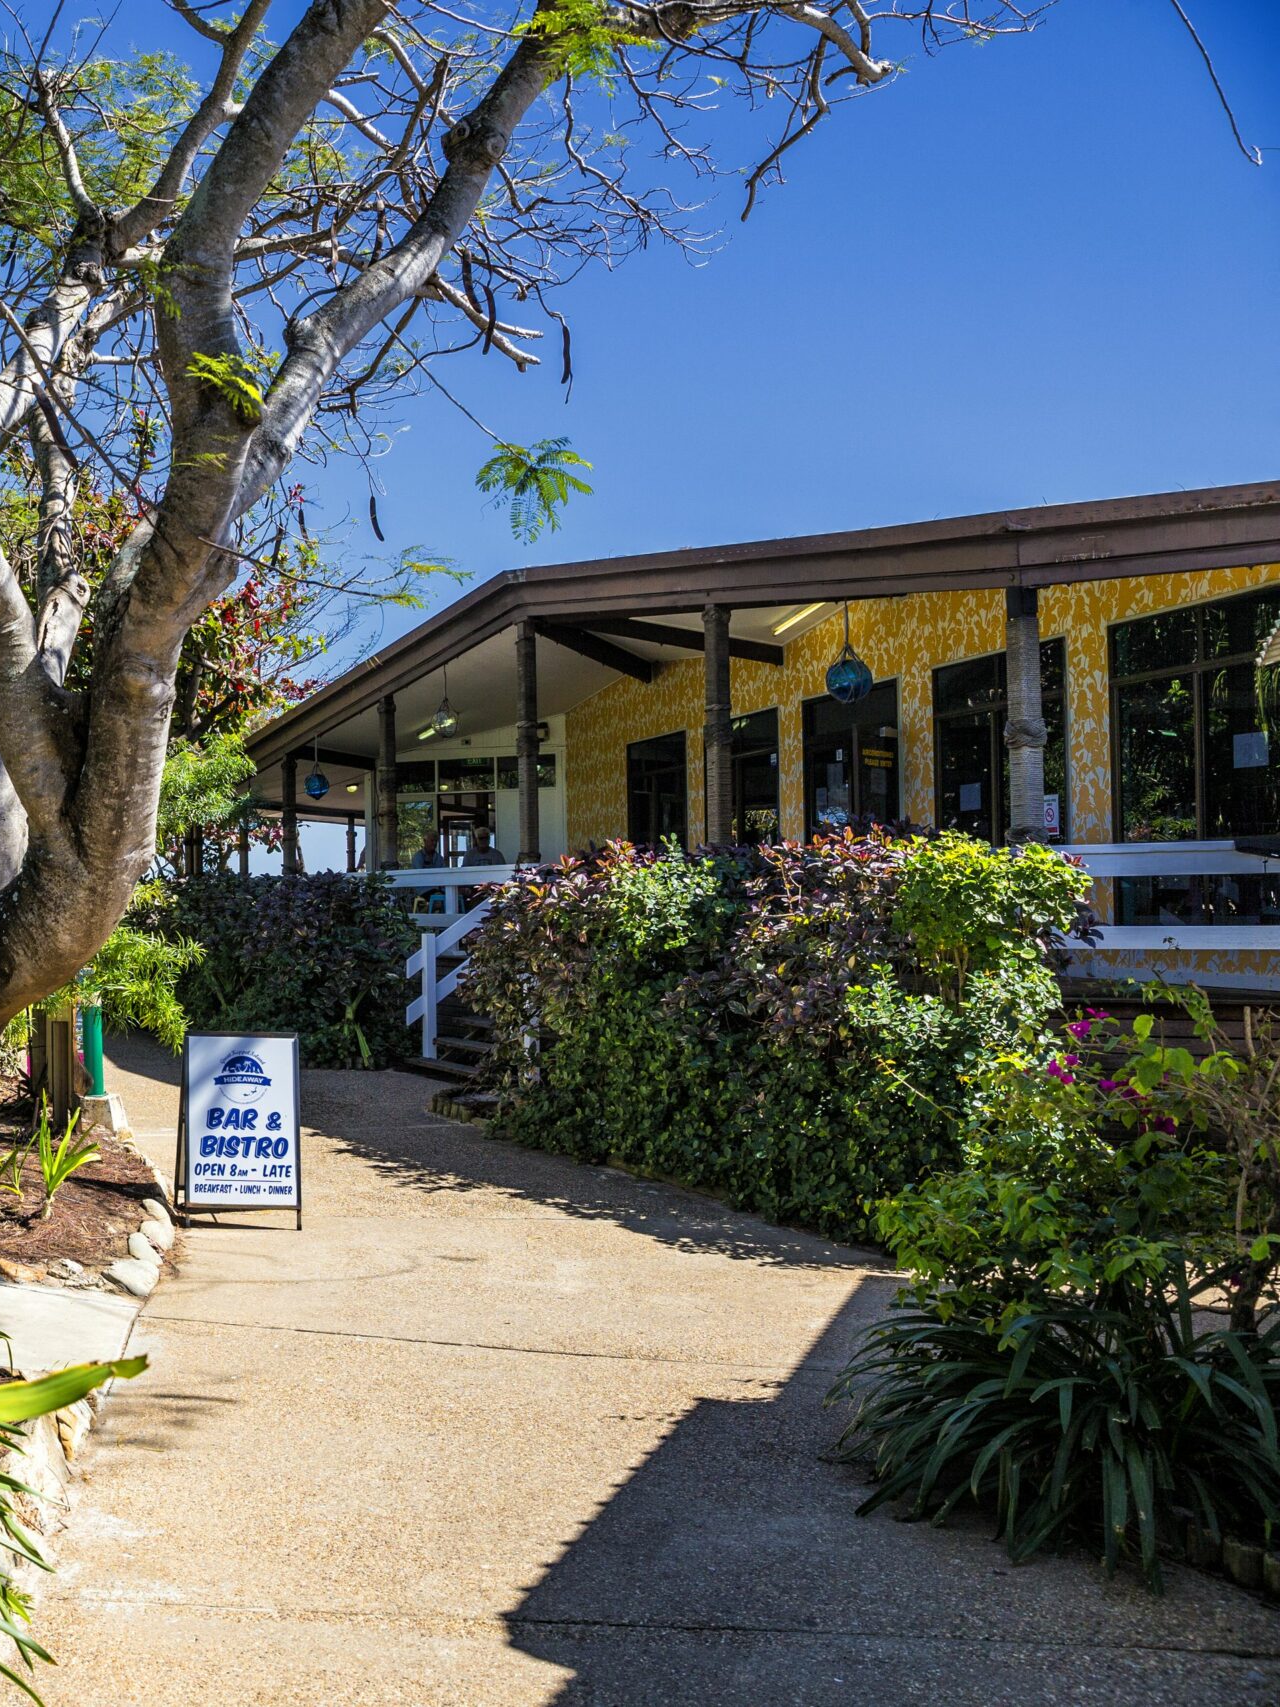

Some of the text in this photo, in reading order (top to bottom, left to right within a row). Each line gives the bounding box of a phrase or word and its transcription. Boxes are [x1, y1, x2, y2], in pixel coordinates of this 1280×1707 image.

[223, 1076, 264, 1084] HIDEAWAY
[206, 1107, 282, 1131] BAR &
[199, 1135, 289, 1159] BISTRO
[194, 1163, 226, 1176] OPEN
[262, 1164, 292, 1178] LATE
[194, 1183, 293, 1195] BREAKFAST LUNCH DINNER
